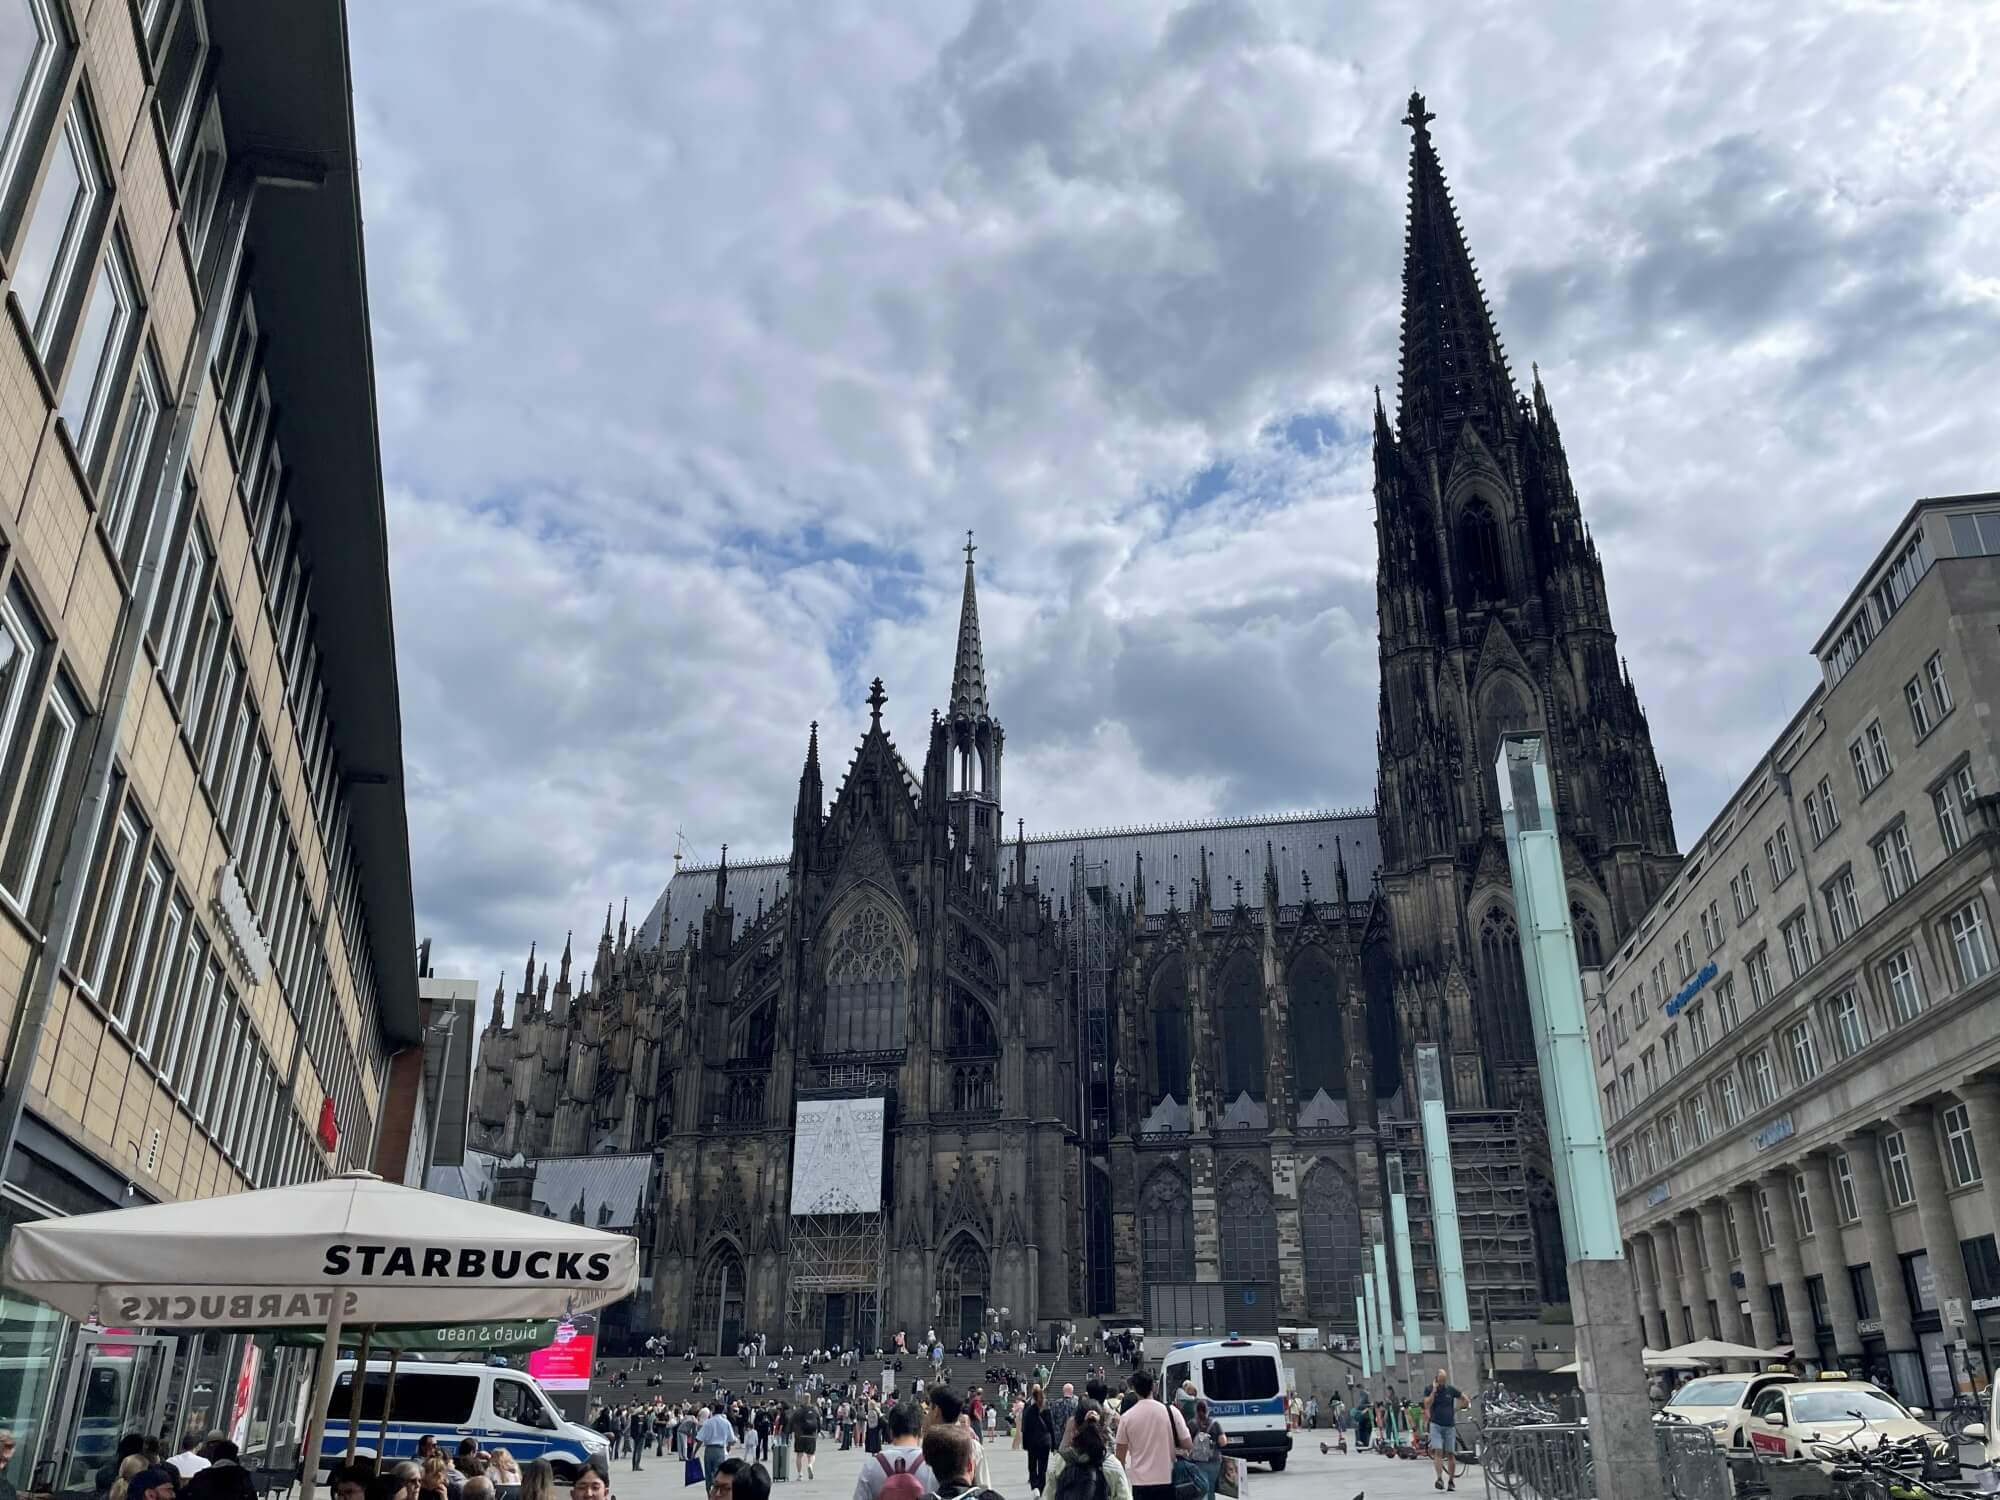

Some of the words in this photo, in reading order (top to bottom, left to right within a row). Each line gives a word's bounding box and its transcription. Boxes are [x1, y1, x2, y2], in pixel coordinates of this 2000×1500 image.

[322, 1244, 611, 1281] STARBUCKS
[437, 1328, 476, 1341] dean
[480, 1326, 490, 1340] &
[494, 1326, 537, 1340] david
